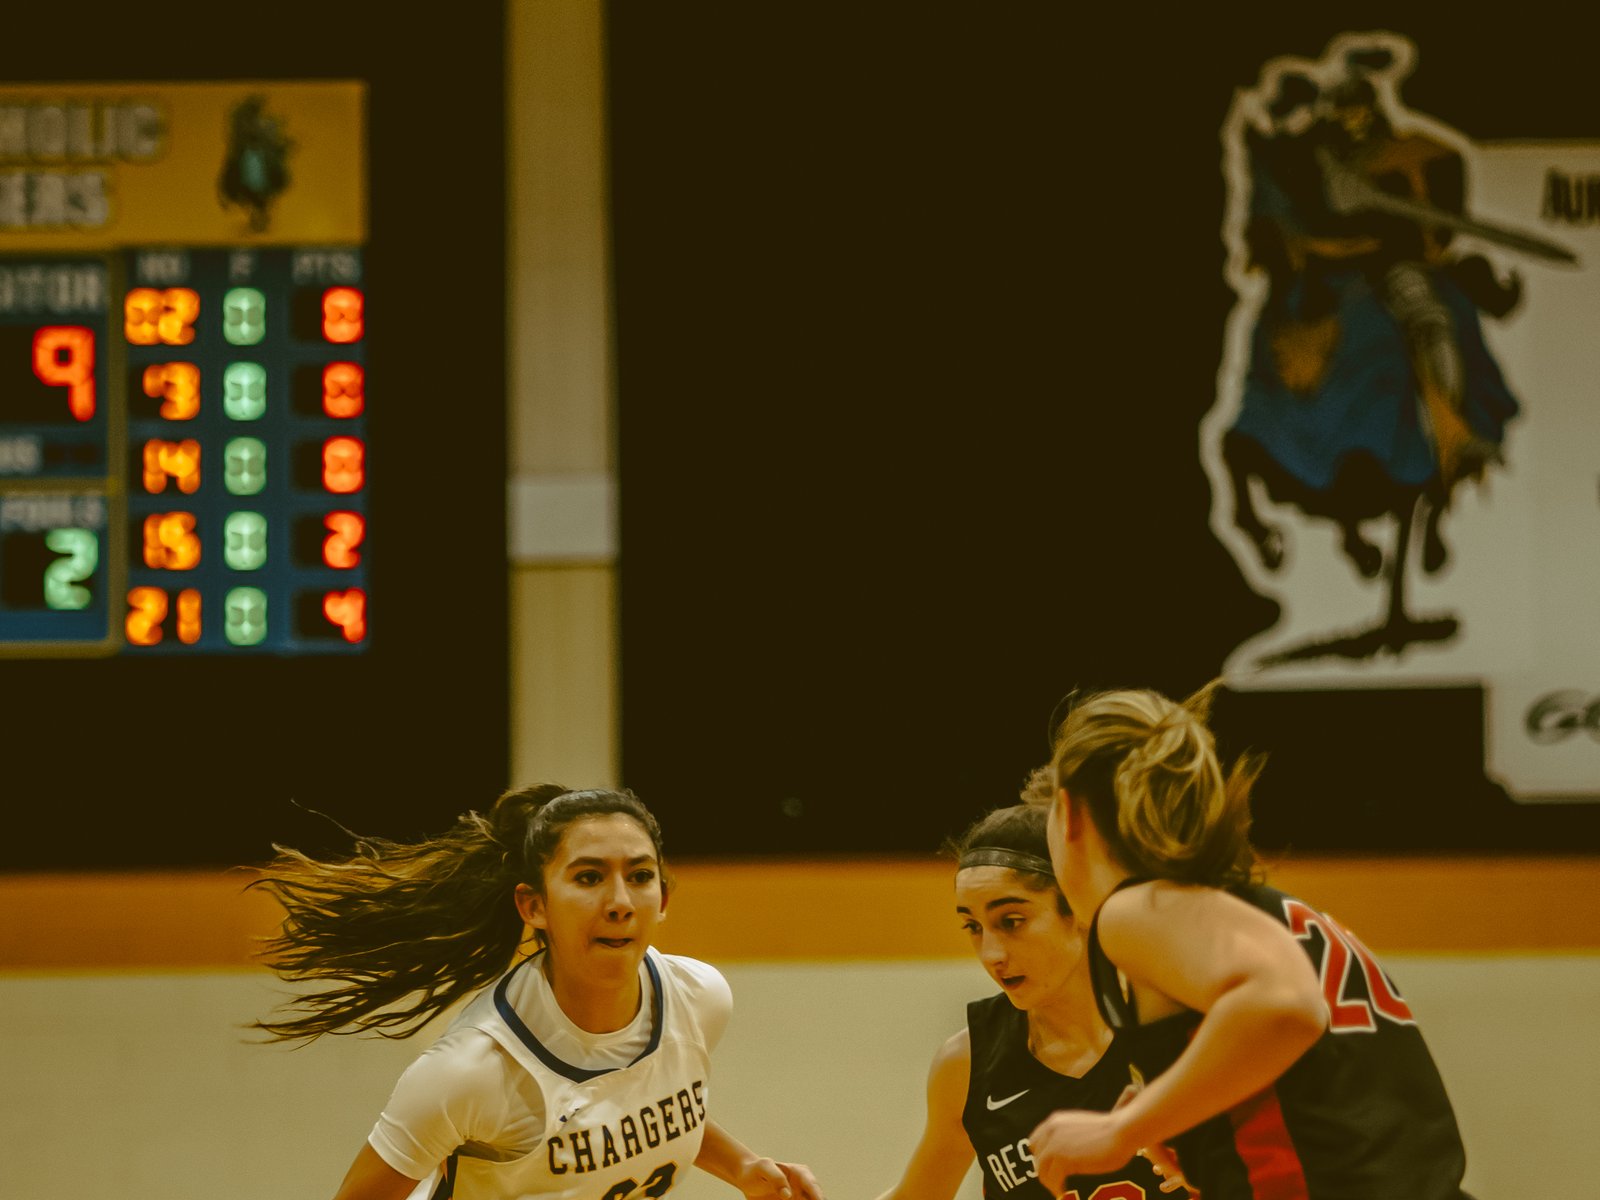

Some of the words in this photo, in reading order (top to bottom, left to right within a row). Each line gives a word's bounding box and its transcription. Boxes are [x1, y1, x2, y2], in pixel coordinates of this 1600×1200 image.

[32, 325, 96, 422] 9
[44, 527, 98, 610] 2
[323, 509, 366, 569] 2
[125, 586, 202, 645] 21
[547, 1080, 706, 1176] CHARGERS
